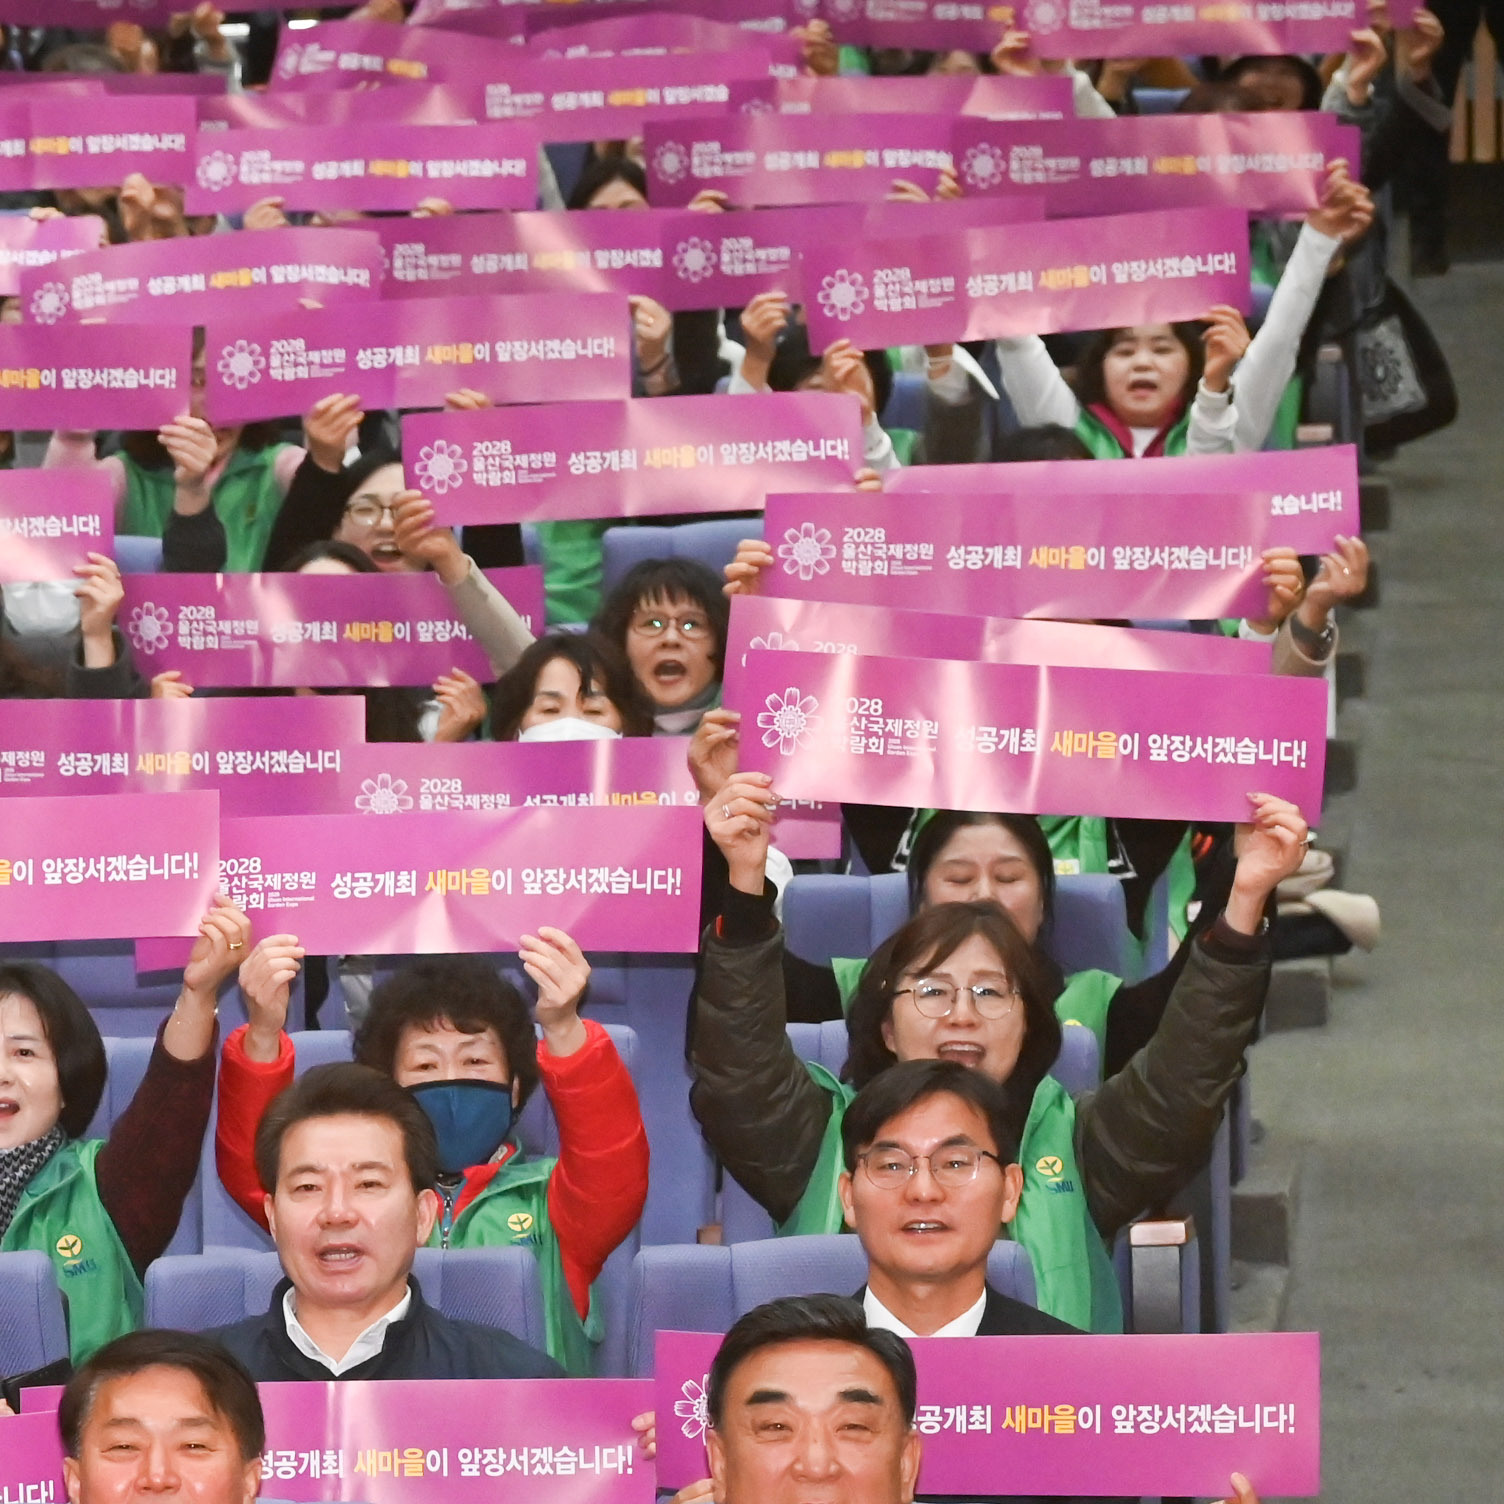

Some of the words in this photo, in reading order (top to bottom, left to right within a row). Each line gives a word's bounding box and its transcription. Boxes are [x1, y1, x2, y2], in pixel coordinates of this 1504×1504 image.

[946, 545, 1022, 569] 성공개최
[1028, 544, 1105, 571] 새마을이
[1112, 545, 1252, 570] 앞장서겠습니다!
[42, 851, 198, 884] 앞장서겠습니다!
[330, 870, 416, 899] 성공개최
[424, 867, 512, 896] 새마을이
[522, 867, 682, 895] 앞장서겠습니다!
[911, 1404, 992, 1435] 공개최
[1001, 1404, 1101, 1434] 새마을이
[1112, 1403, 1295, 1435] 앞장서겠습니다!
[353, 1447, 448, 1478] 새마을이
[458, 1444, 634, 1477] 앞장서겠습니다!
